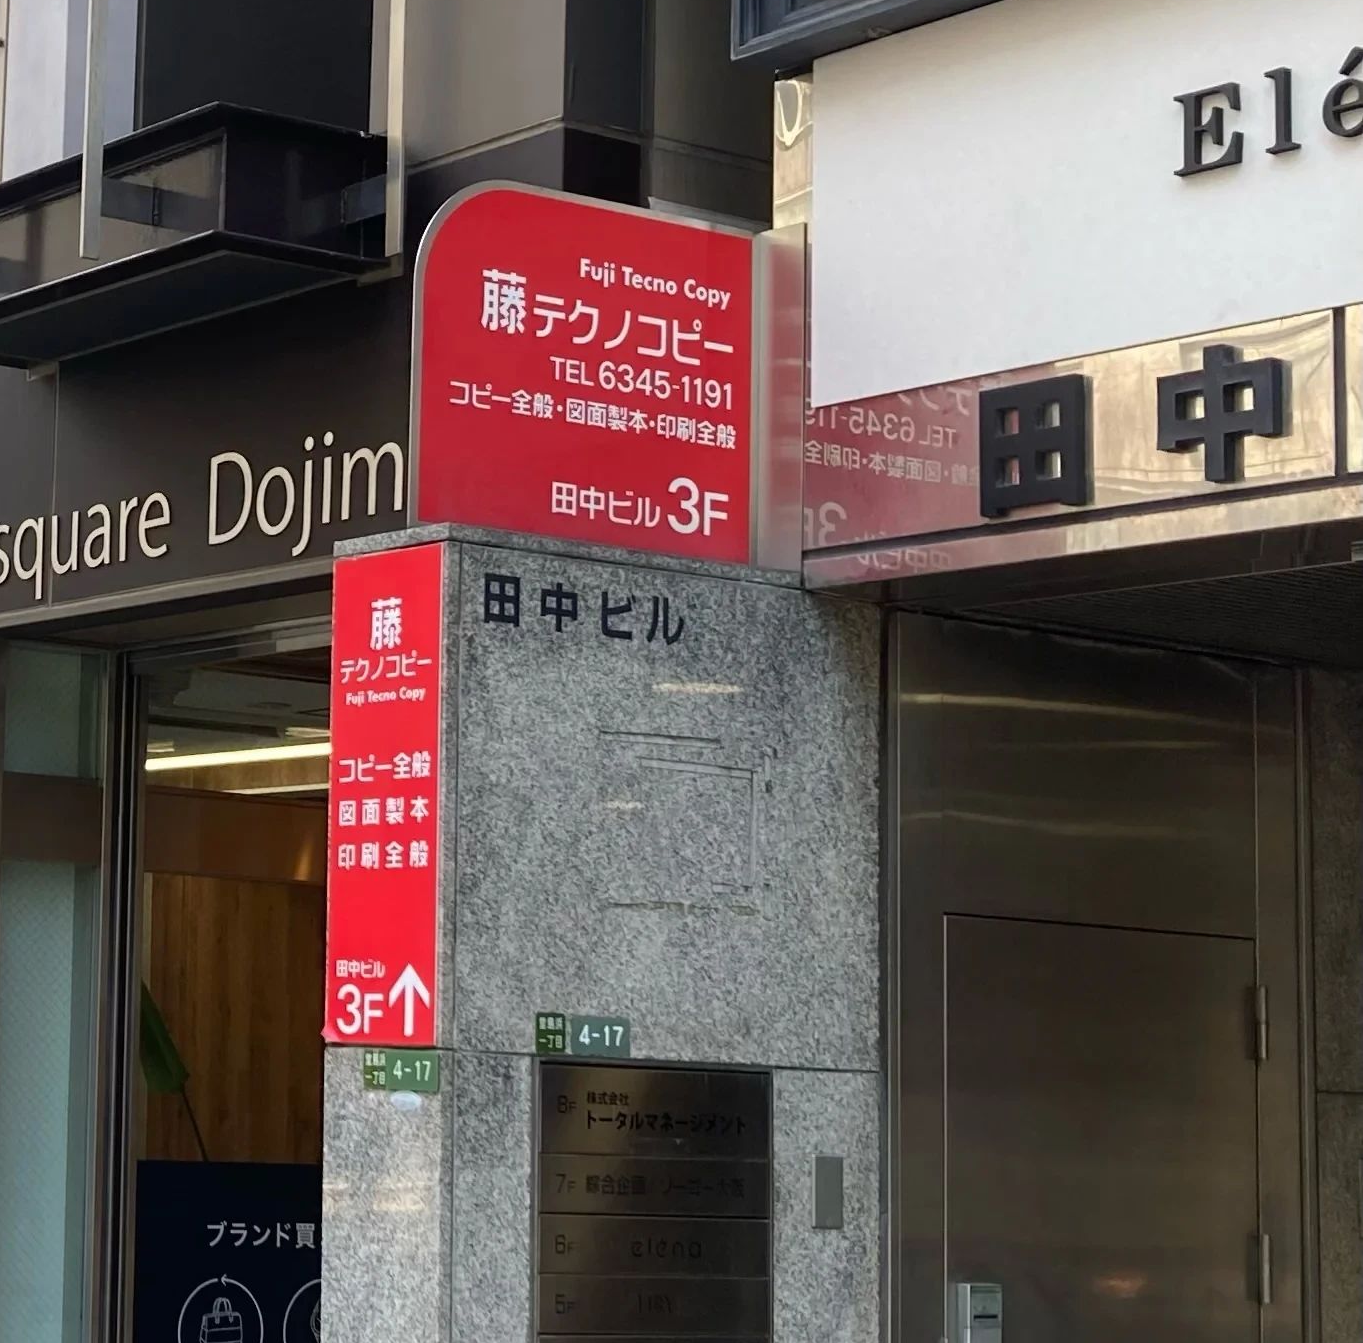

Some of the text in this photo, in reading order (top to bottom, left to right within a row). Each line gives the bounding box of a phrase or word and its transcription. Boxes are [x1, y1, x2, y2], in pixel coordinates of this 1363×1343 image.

[580, 258, 731, 310] Fuji Tecno Copy
[481, 268, 734, 366] 藤テクノコピー
[550, 356, 733, 411] TEL 6345-1191
[449, 379, 736, 450] コピー全般・図面製本・印刷全般
[979, 343, 1292, 520] 田中
[551, 476, 729, 537] 田中ビル 3F
[370, 597, 403, 650] 藤
[483, 572, 685, 646] 田中ビル
[340, 650, 432, 685] テクノコピー
[345, 685, 427, 706] Fuji Tecno Copy
[339, 750, 432, 784] コピー全般
[338, 795, 430, 827] 図面製本
[337, 840, 429, 870] 印刷全般
[336, 958, 385, 979] 田中ビル
[336, 982, 385, 1036] 3F
[579, 1024, 625, 1047] 4-17
[392, 1059, 432, 1082] 4-17
